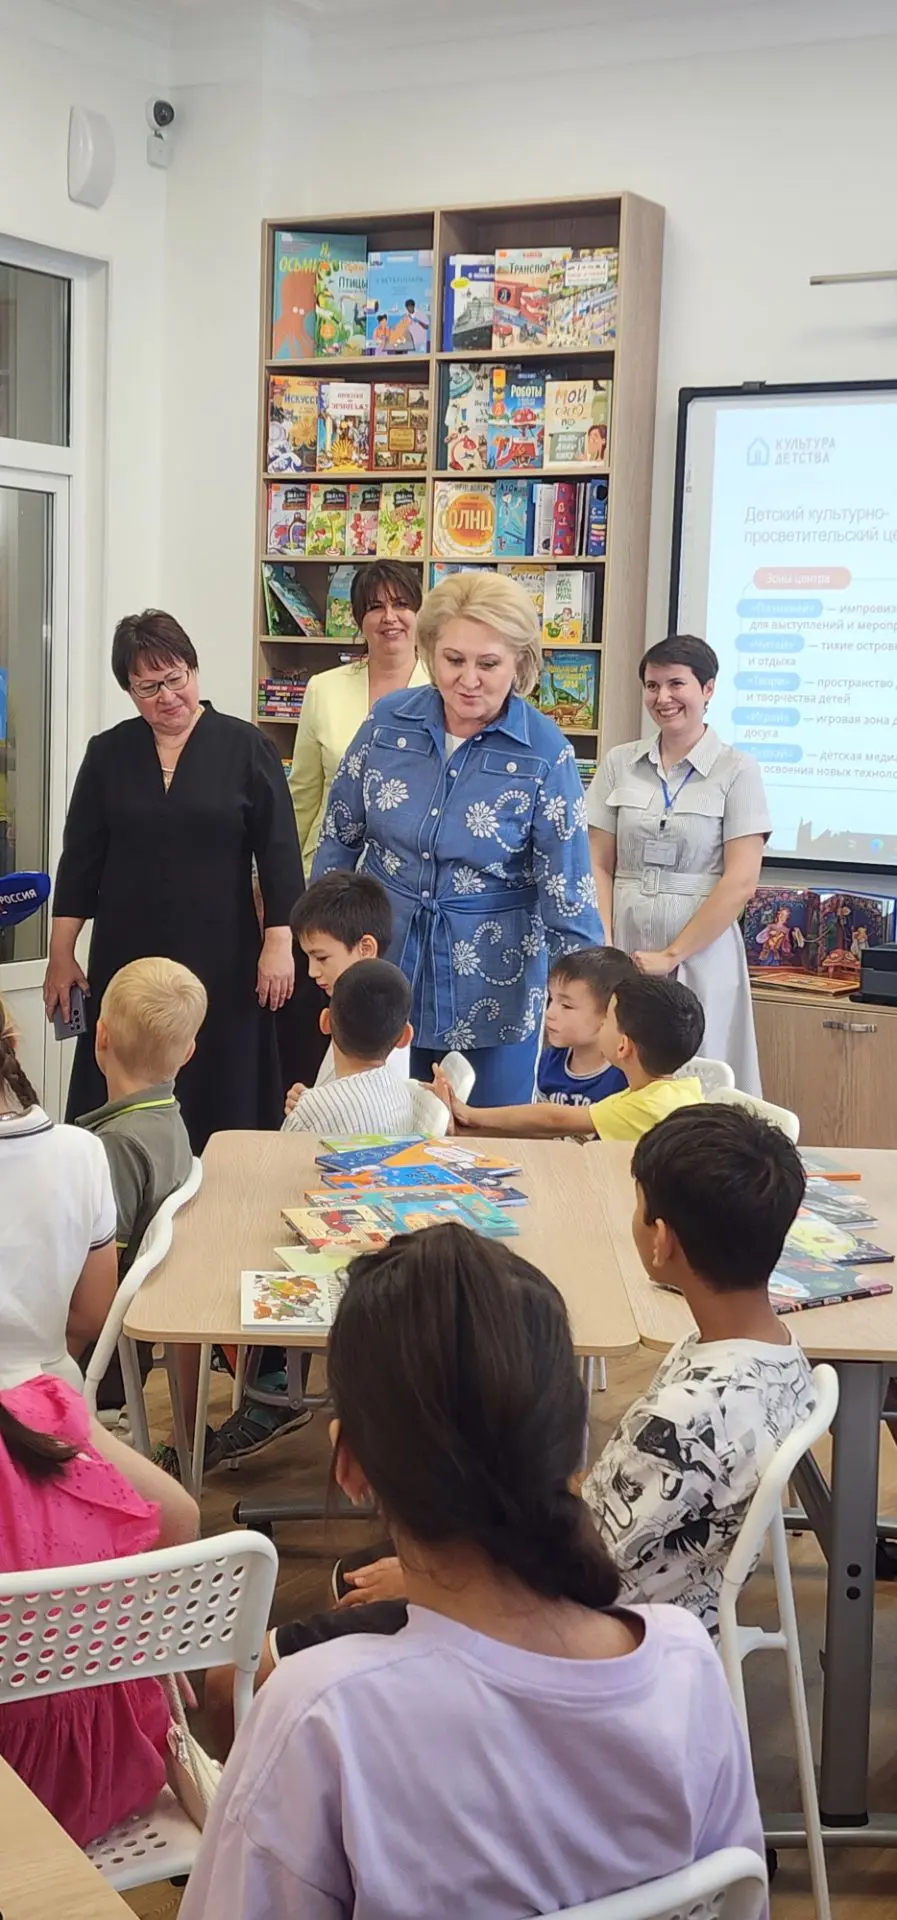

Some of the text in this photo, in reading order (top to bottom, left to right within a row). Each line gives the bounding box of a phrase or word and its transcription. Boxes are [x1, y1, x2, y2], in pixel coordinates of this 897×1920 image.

[511, 384, 542, 398] РОБОТЫ
[555, 384, 587, 404] МОЙ
[775, 437, 835, 450] КУЛЬТУРА
[774, 452, 830, 466] ДЕТСТВА
[744, 505, 889, 525] Детский культурно-
[744, 527, 879, 546] просветительский
[766, 573, 831, 586] Зоны центра
[749, 620, 768, 631] для
[771, 620, 844, 633] выступлений
[847, 622, 855, 631] и
[821, 641, 854, 651] тихие
[748, 657, 796, 667] и отдыха
[817, 679, 894, 690] пространство
[746, 693, 851, 705] и творчества детей
[816, 715, 862, 727] игровая
[863, 715, 890, 725] зона
[744, 729, 779, 740] досуга
[820, 751, 862, 762] детская
[764, 765, 813, 775] освоения
[816, 766, 851, 776] новых
[0, 888, 38, 905] РОССИЯ
